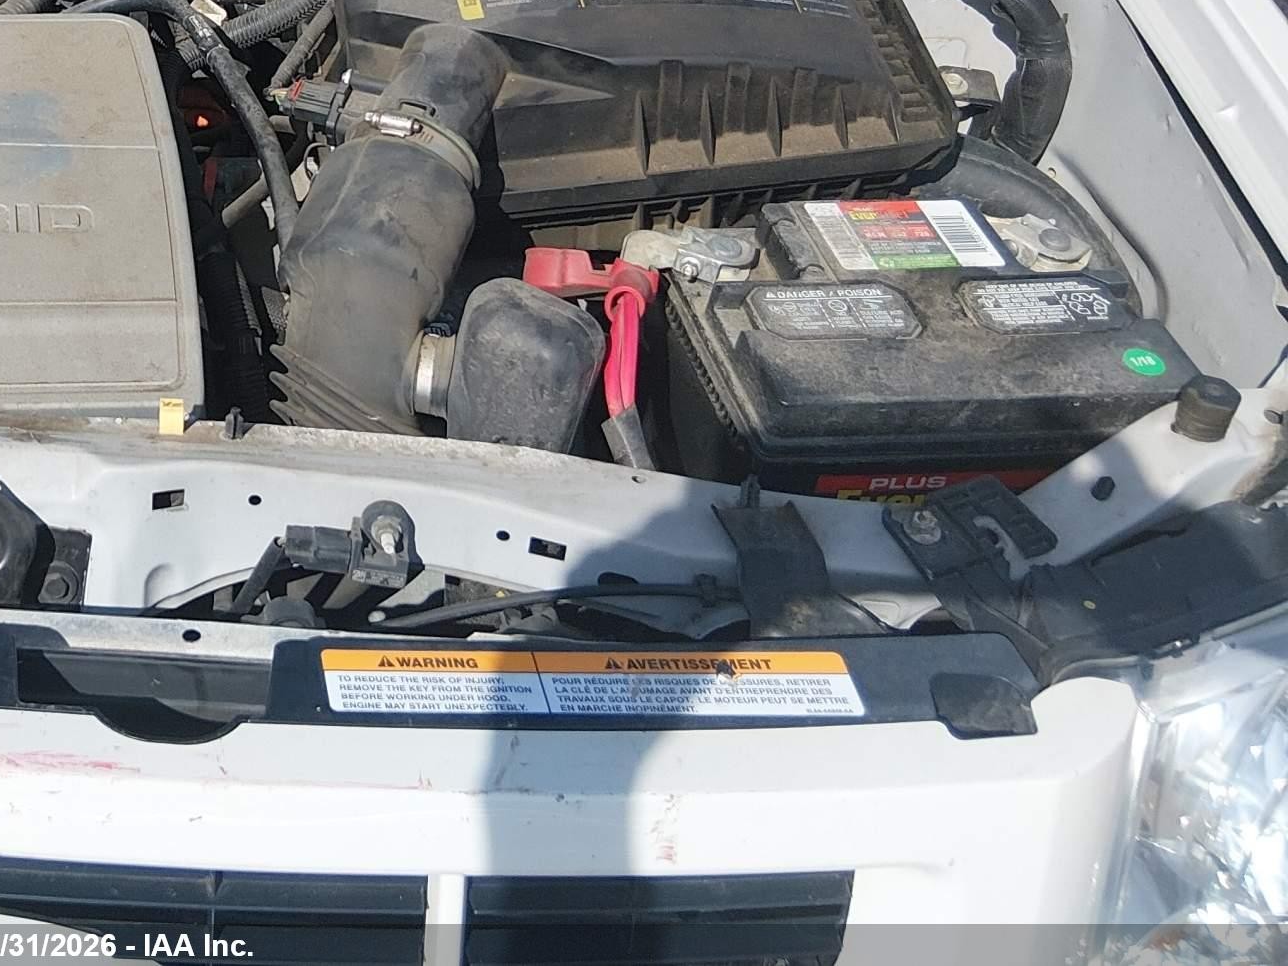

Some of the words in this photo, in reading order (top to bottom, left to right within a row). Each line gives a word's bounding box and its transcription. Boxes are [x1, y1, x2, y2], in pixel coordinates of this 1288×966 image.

[776, 290, 825, 299] DANGER
[837, 288, 882, 297] POISON
[870, 476, 947, 490] PLUS
[396, 657, 478, 668] WARNING
[626, 658, 772, 670] AVERTISSEMENT
[584, 676, 630, 686] RÉDUIRE
[654, 678, 699, 686] RISQUES
[555, 687, 569, 695] LA
[572, 685, 591, 695] CLÉ
[594, 687, 608, 695] DE
[558, 696, 606, 704] TRAVAUX
[611, 696, 638, 704] SOUS
[642, 696, 654, 704] LE
